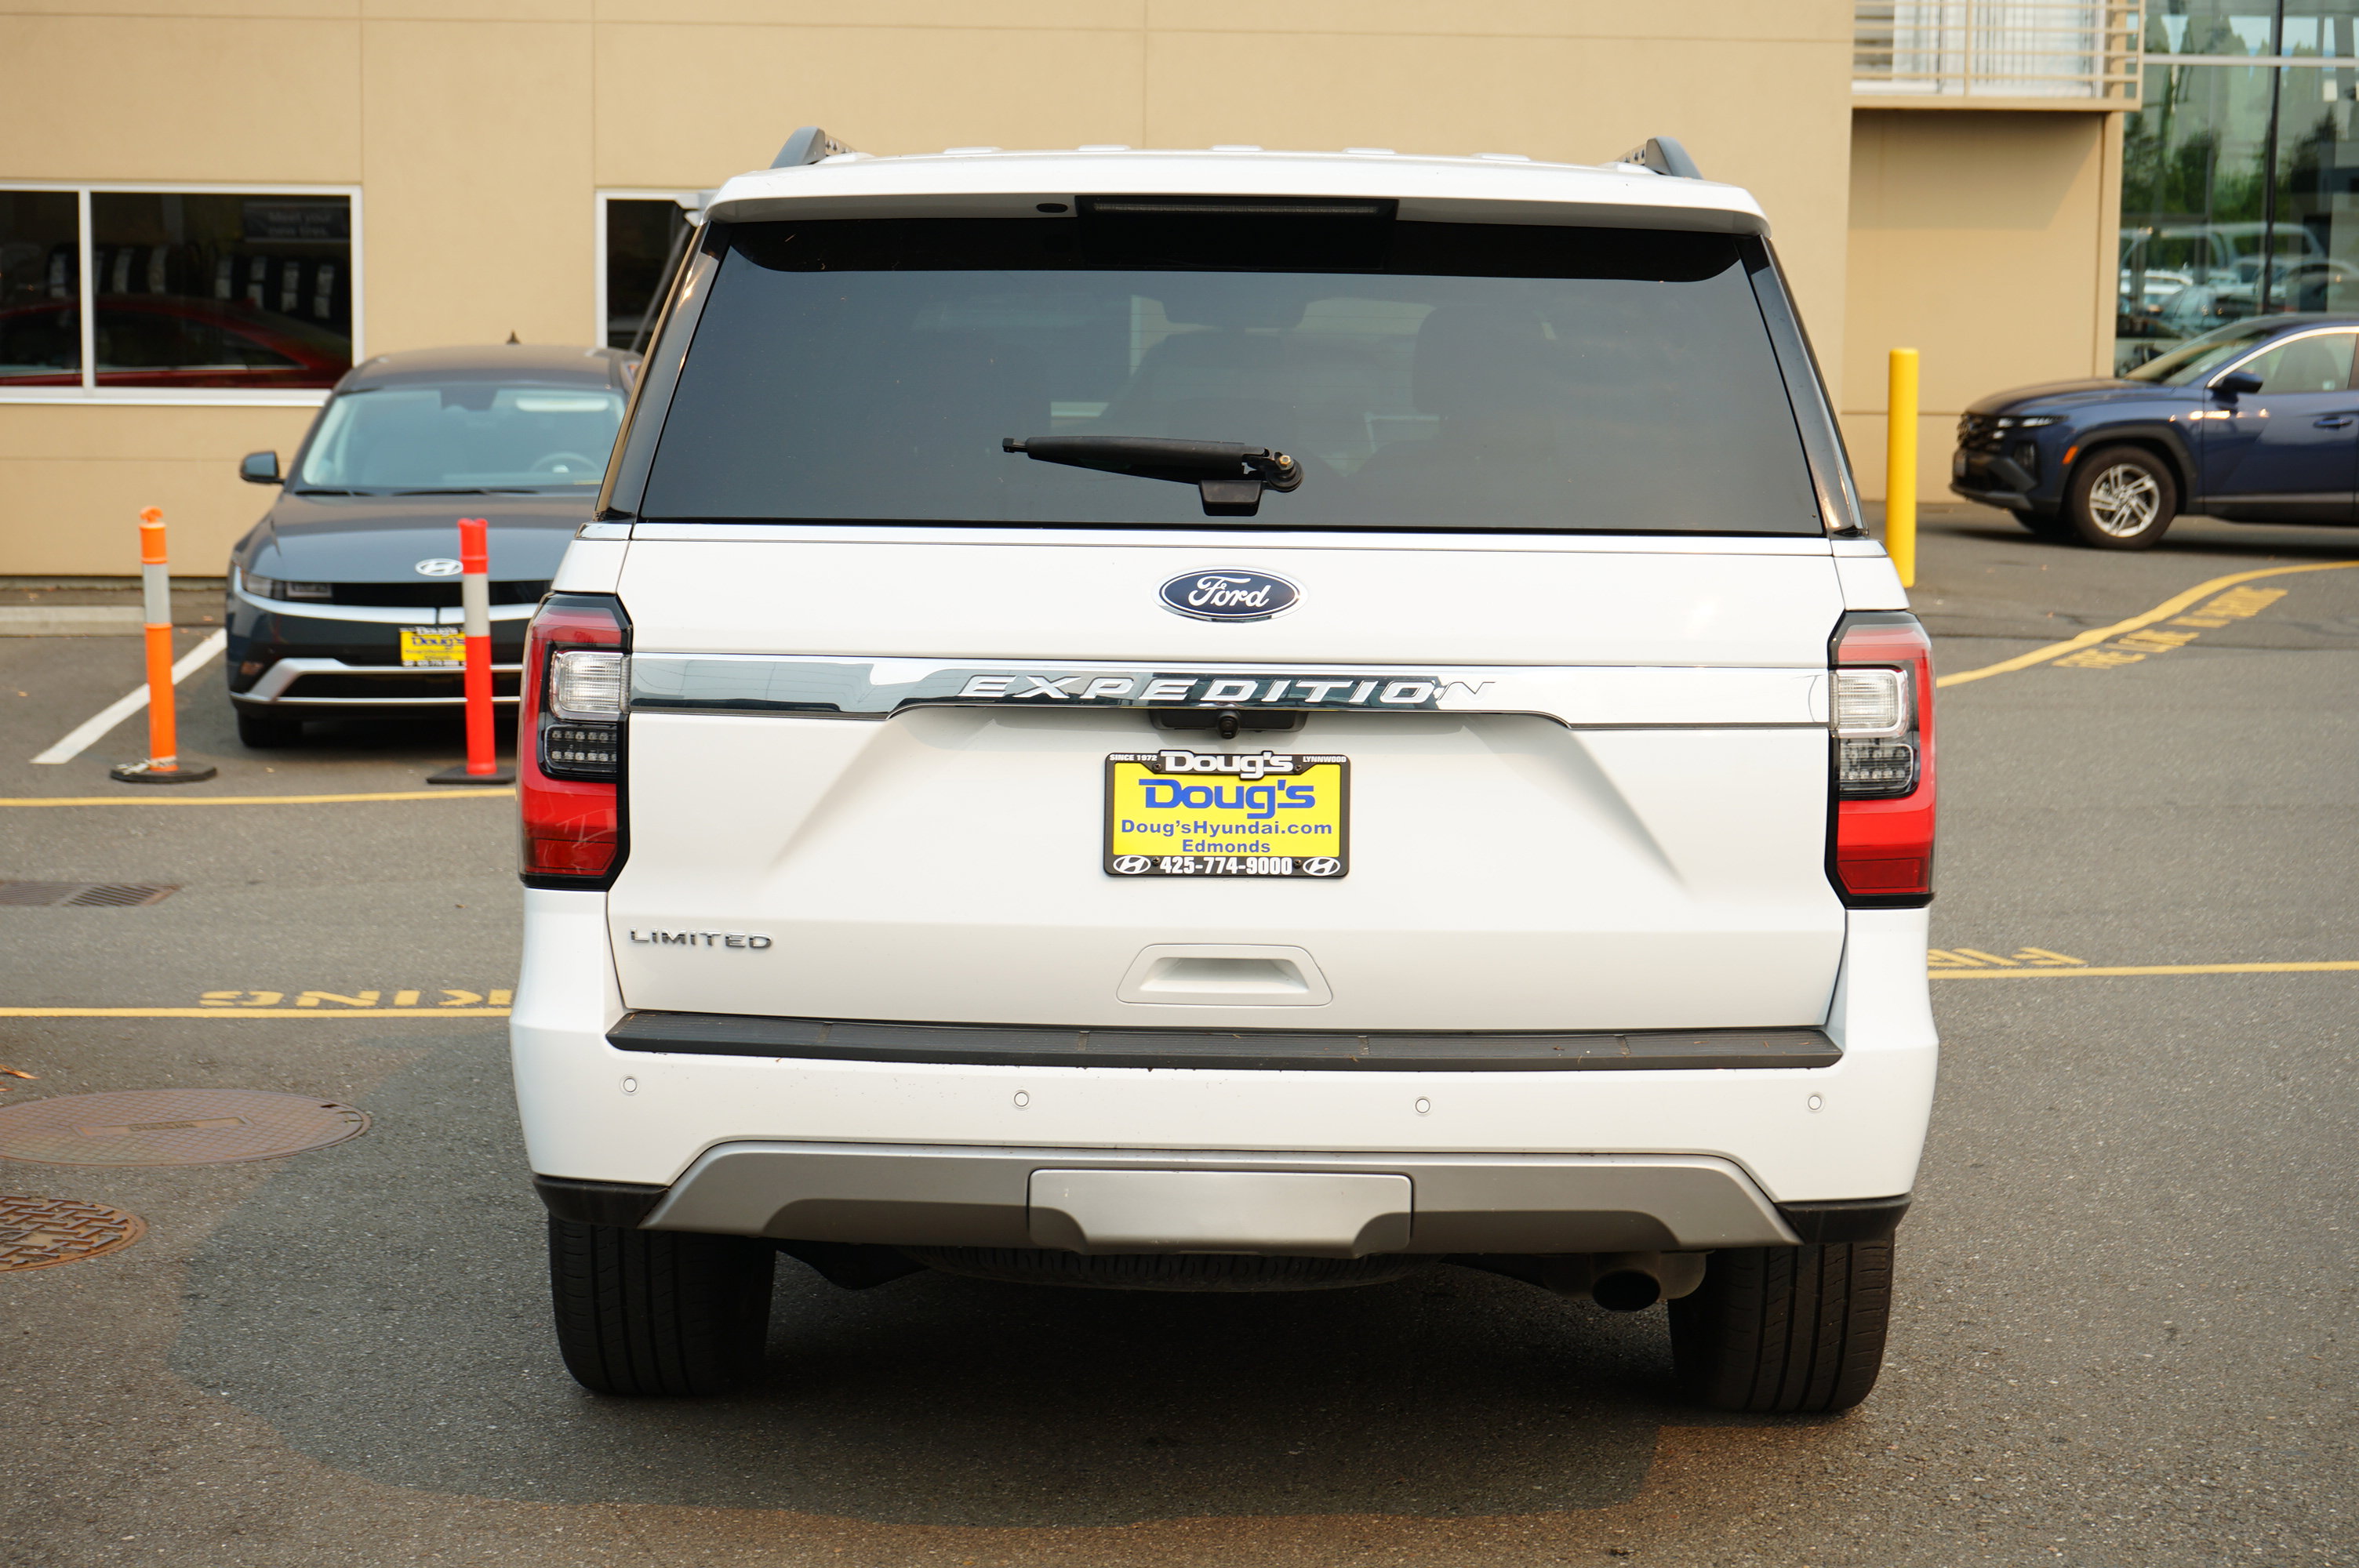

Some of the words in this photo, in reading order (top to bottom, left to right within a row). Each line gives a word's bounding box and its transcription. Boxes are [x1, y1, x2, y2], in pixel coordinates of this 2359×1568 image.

[1188, 575, 1271, 608] Ford
[958, 675, 1495, 703] EXPEDITION
[1161, 751, 1293, 779] Doug's
[1139, 779, 1315, 819] Doug's
[1121, 819, 1332, 837] Doug'sHyundai.com
[1182, 839, 1270, 853] Edmonds
[1159, 856, 1292, 875] 425-774-9000
[630, 927, 772, 949] LIMITED
[198, 989, 513, 1007] KING
